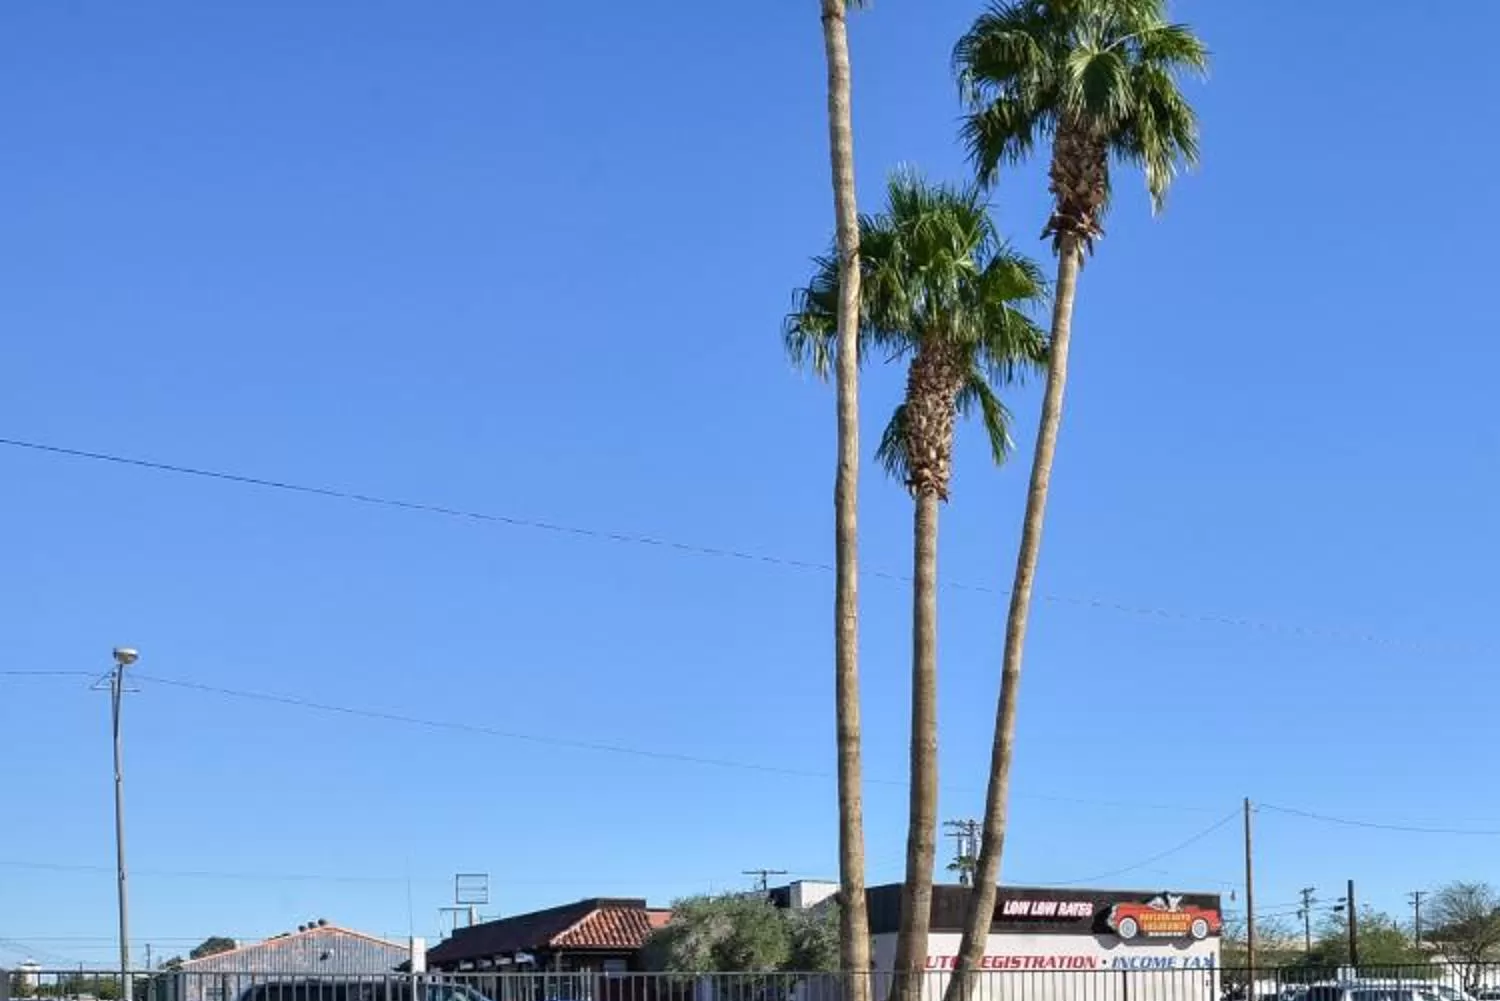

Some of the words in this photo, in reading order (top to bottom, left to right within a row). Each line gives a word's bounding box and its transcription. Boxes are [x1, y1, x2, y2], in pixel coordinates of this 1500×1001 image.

[1003, 901, 1031, 915] LOW
[1030, 901, 1058, 916] LOW
[1057, 902, 1093, 917] RATES
[980, 955, 1097, 969] EGISTRATION
[1112, 956, 1176, 969] INCOME
